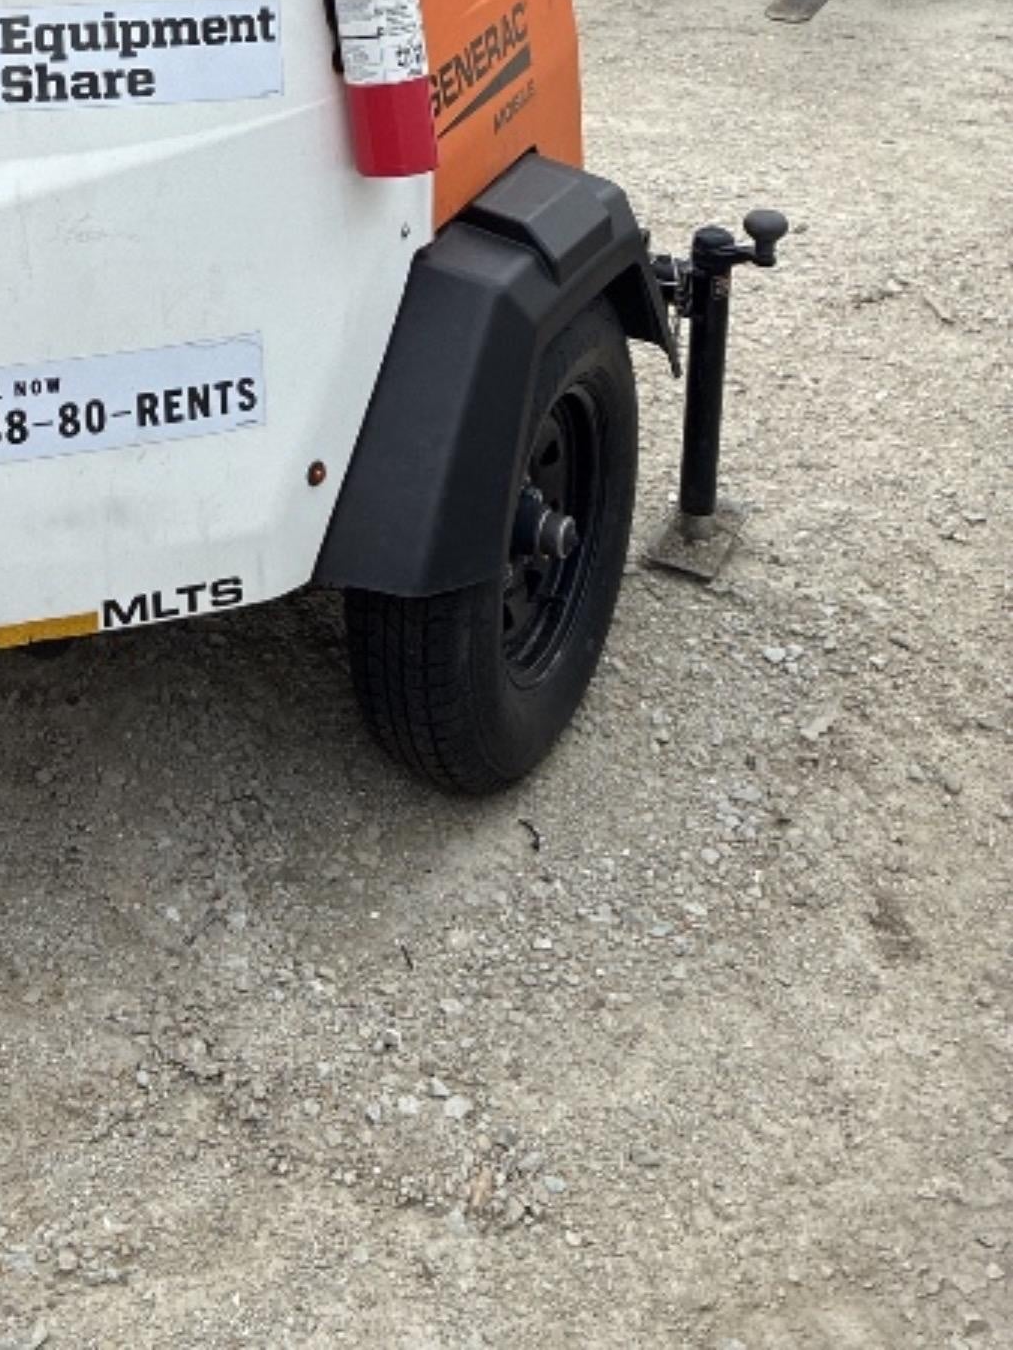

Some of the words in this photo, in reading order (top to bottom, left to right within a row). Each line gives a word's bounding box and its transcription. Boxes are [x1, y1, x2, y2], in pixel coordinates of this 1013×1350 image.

[0, 62, 156, 104] Share
[13, 377, 62, 398] NOW
[102, 575, 244, 628] MLTS
